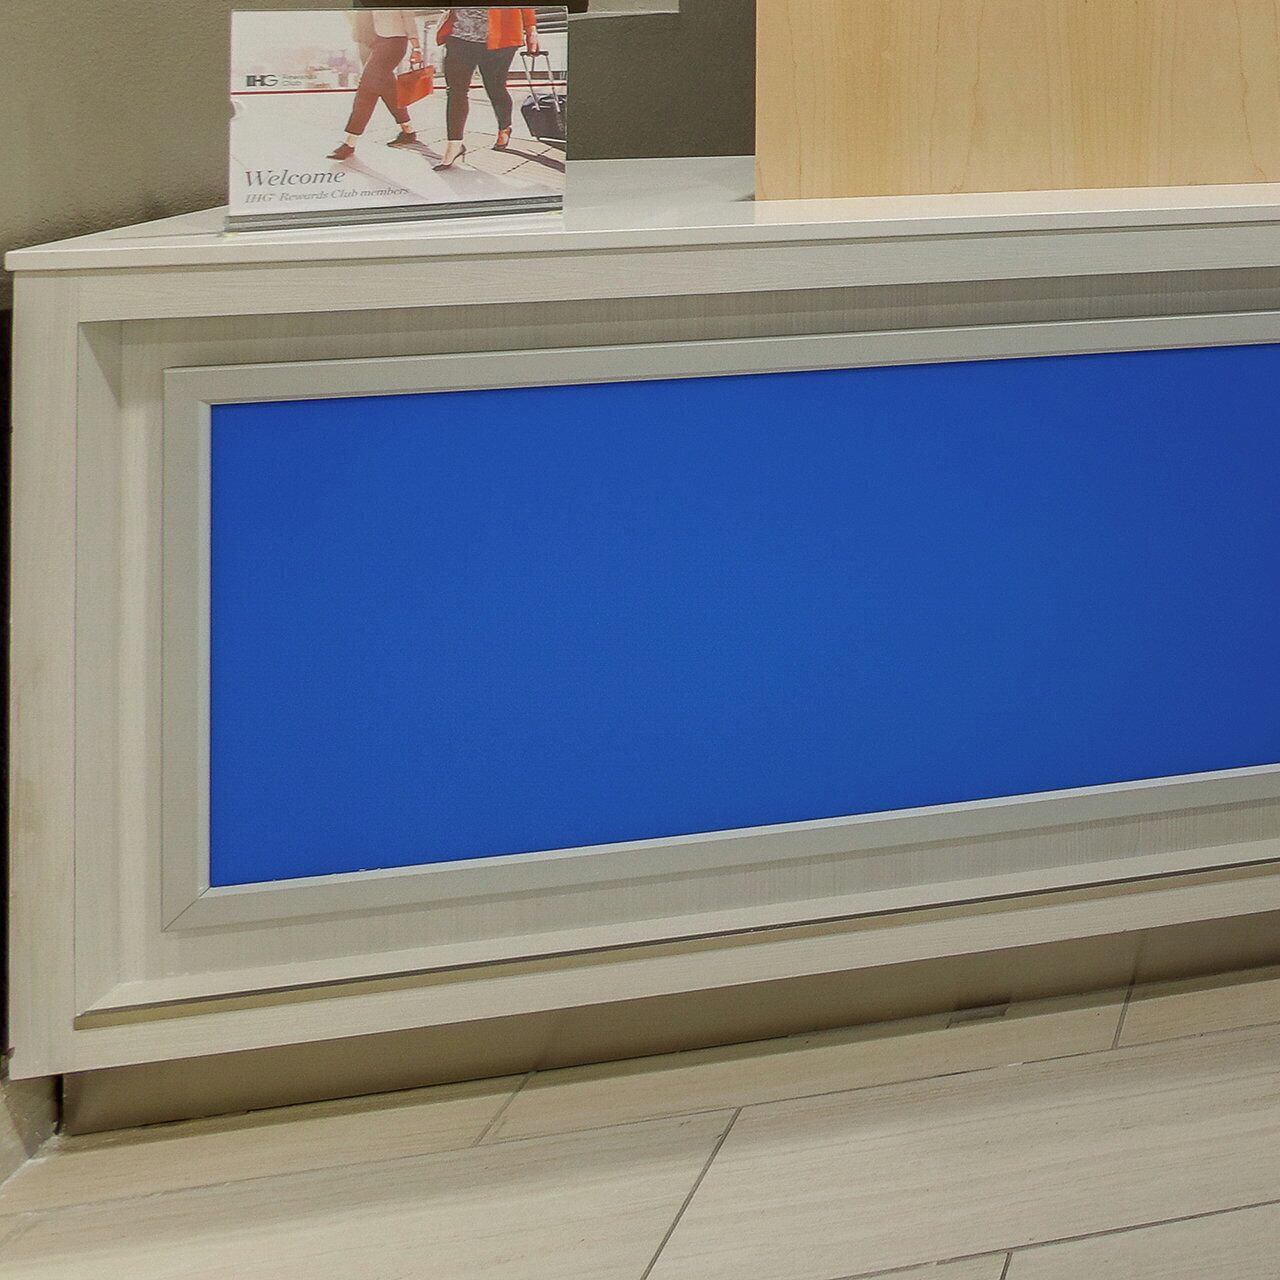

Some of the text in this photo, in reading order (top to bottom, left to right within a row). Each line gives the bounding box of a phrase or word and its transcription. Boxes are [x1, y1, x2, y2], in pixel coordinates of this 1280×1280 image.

[245, 74, 279, 87] IHG
[244, 169, 346, 187] Welcome
[279, 190, 329, 202] Rewards
[330, 187, 358, 199] Club
[359, 185, 410, 197] members
